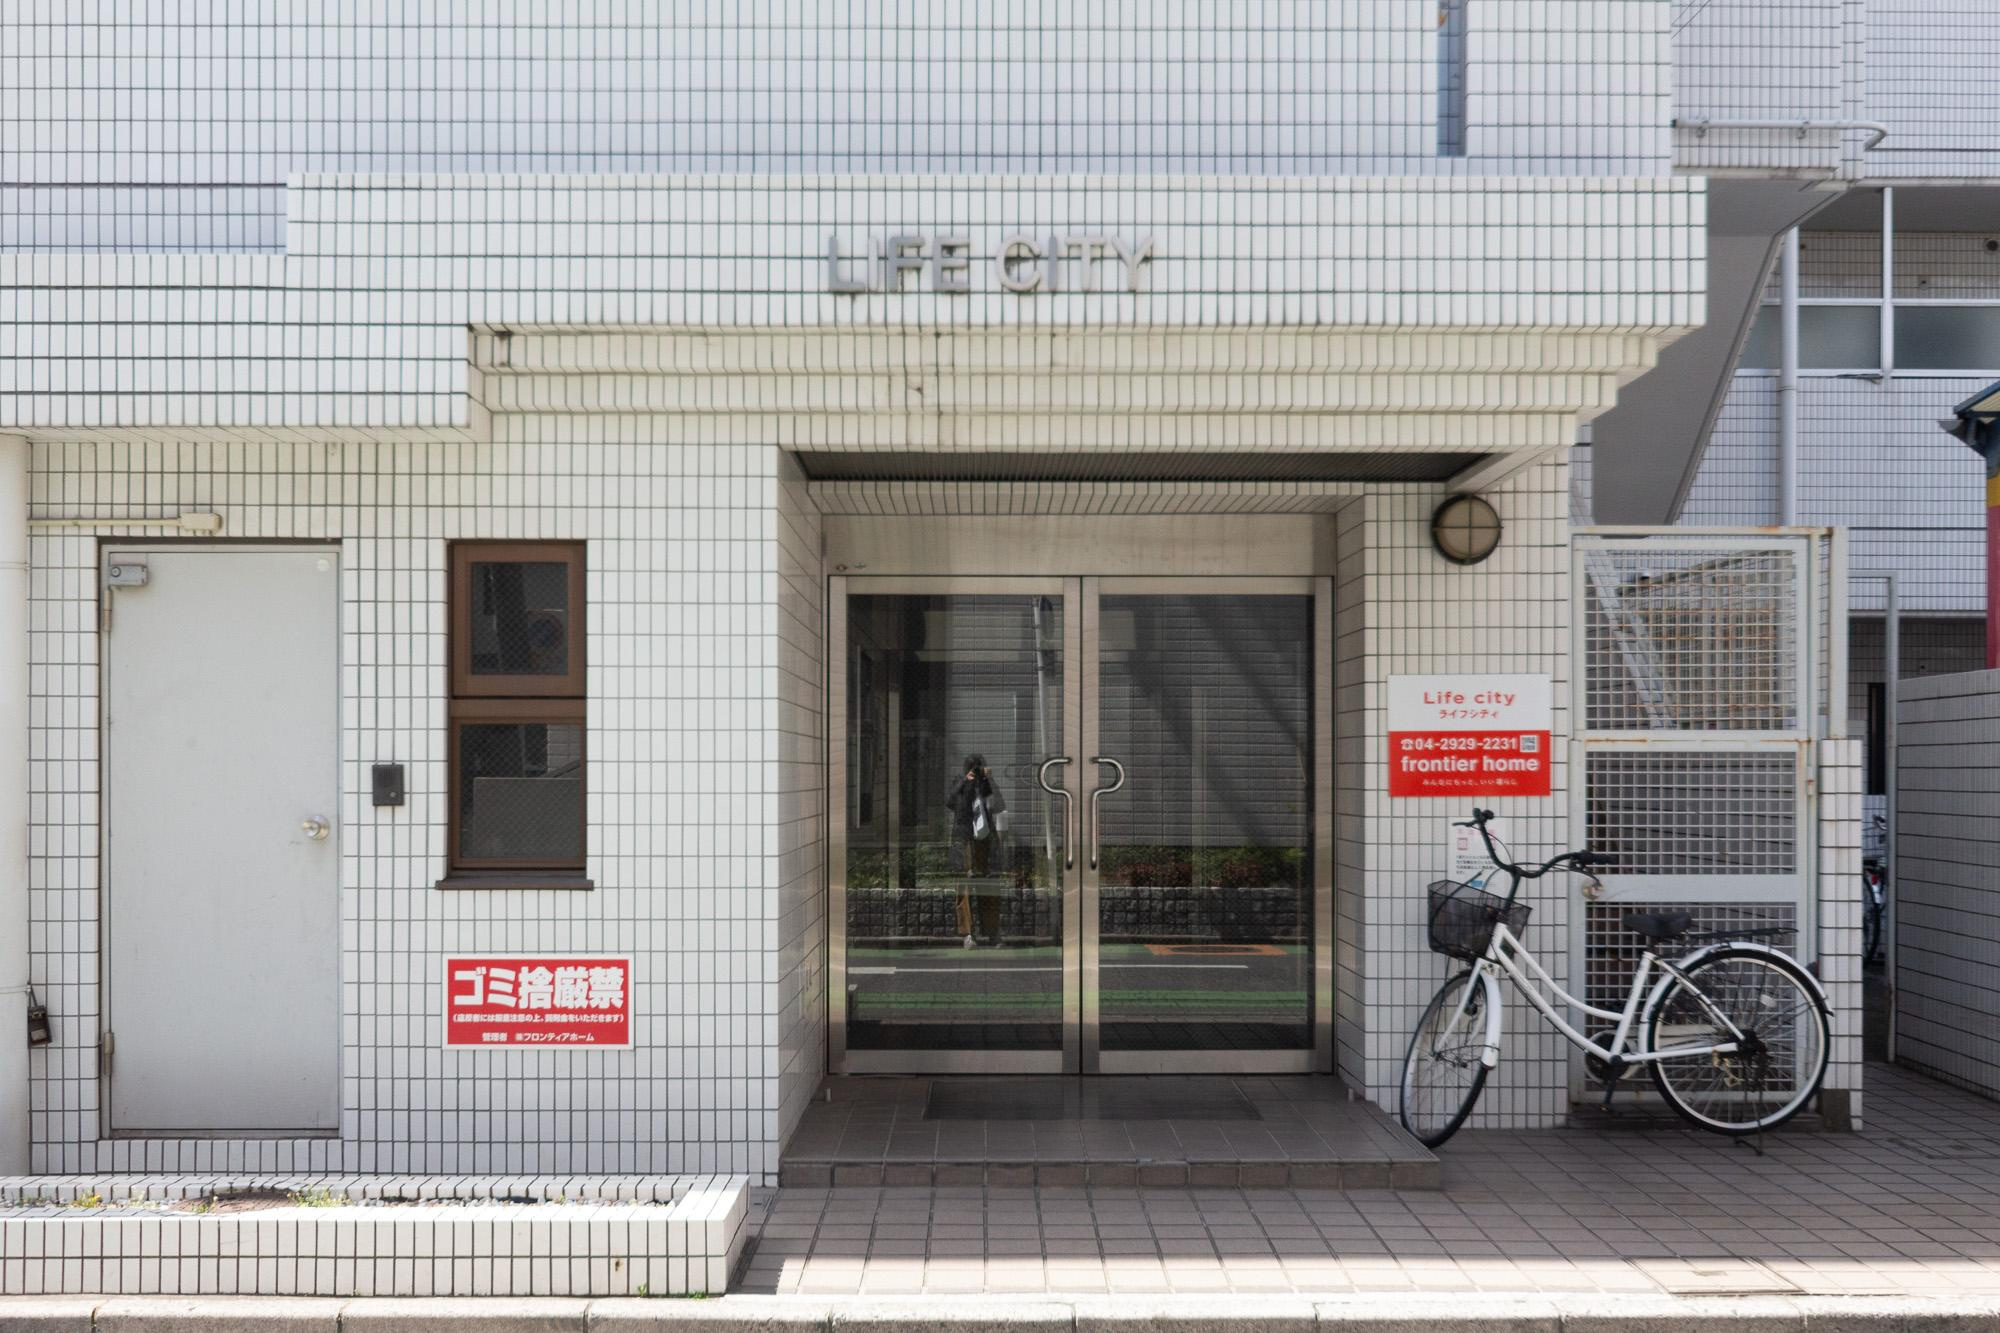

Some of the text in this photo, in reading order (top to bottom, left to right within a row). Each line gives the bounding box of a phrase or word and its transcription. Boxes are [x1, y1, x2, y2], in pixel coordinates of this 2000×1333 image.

[828, 235, 1153, 293] LIFE CITY
[1424, 691, 1516, 706] Life city
[1439, 710, 1499, 719] ライフシティ
[1401, 756, 1539, 772] frontier home
[454, 966, 624, 1009] ゴミ捨厳禁
